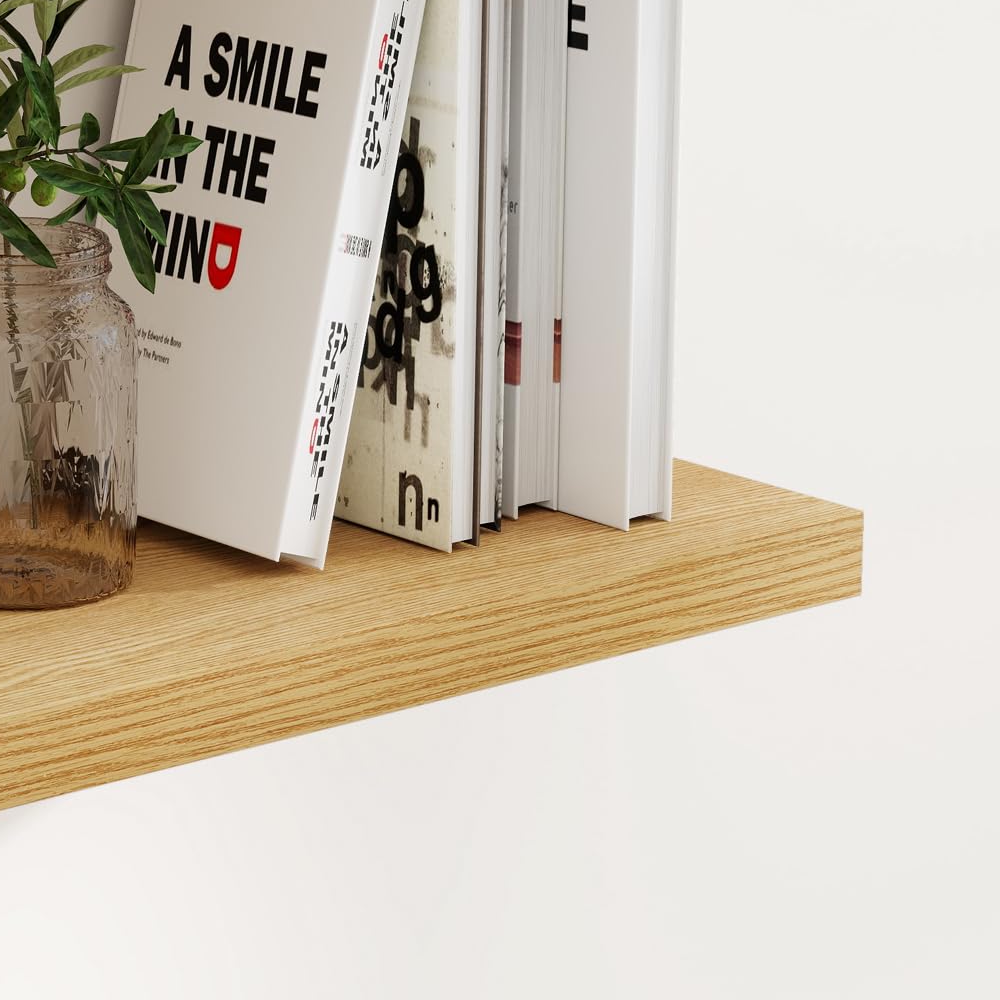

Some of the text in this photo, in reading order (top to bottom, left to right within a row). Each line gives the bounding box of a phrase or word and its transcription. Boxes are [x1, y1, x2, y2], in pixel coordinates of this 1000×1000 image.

[164, 24, 328, 119] A SMILE
[202, 125, 276, 204] THE
[310, 372, 341, 521] SMILE
[311, 388, 333, 478] THE
